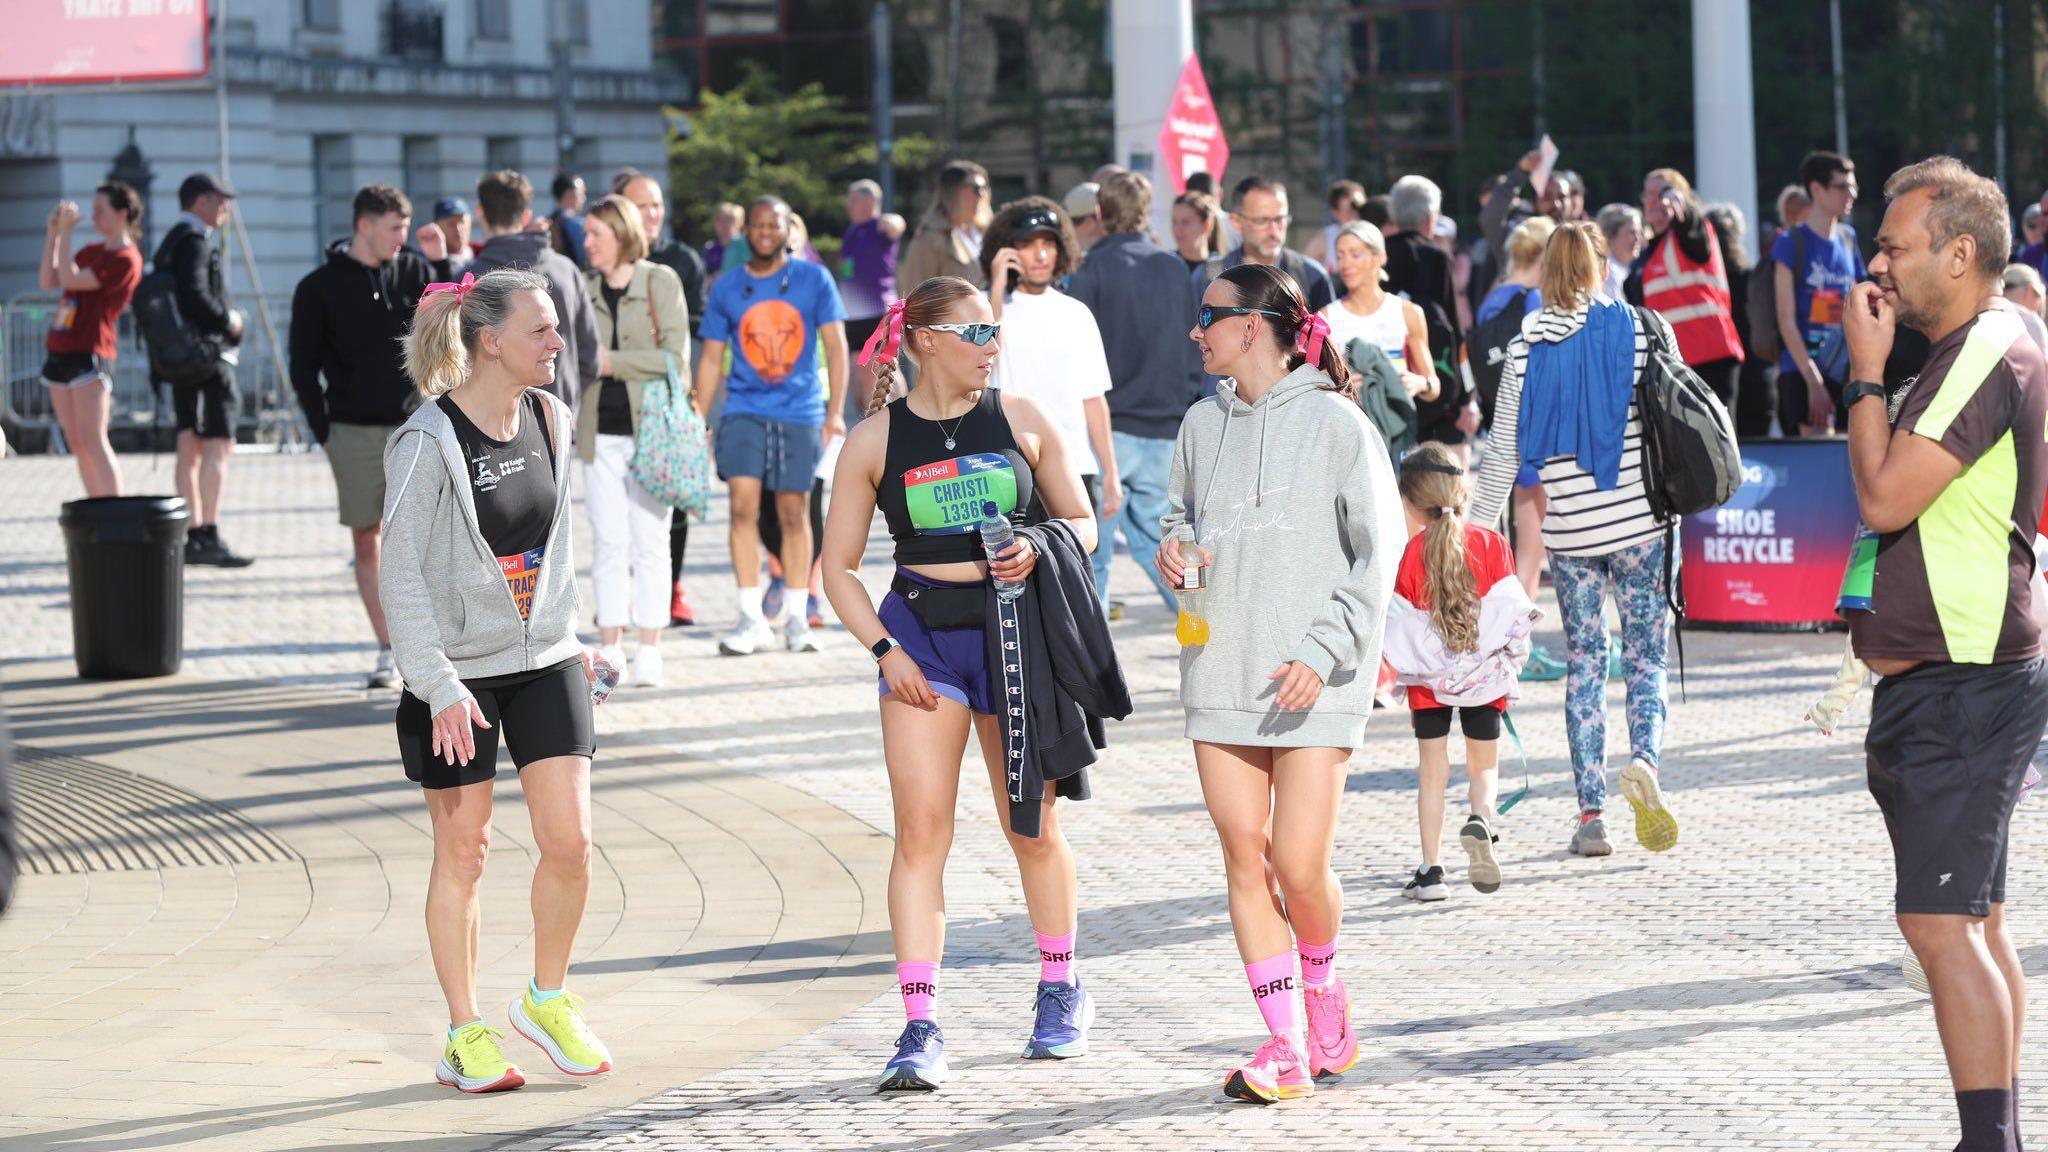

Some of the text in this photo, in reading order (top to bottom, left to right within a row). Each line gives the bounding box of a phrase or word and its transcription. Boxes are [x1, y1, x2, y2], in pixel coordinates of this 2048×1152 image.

[933, 476, 989, 503] CHRISTI
[1716, 508, 1775, 535] SHOE
[1703, 537, 1794, 563] RECYCLE
